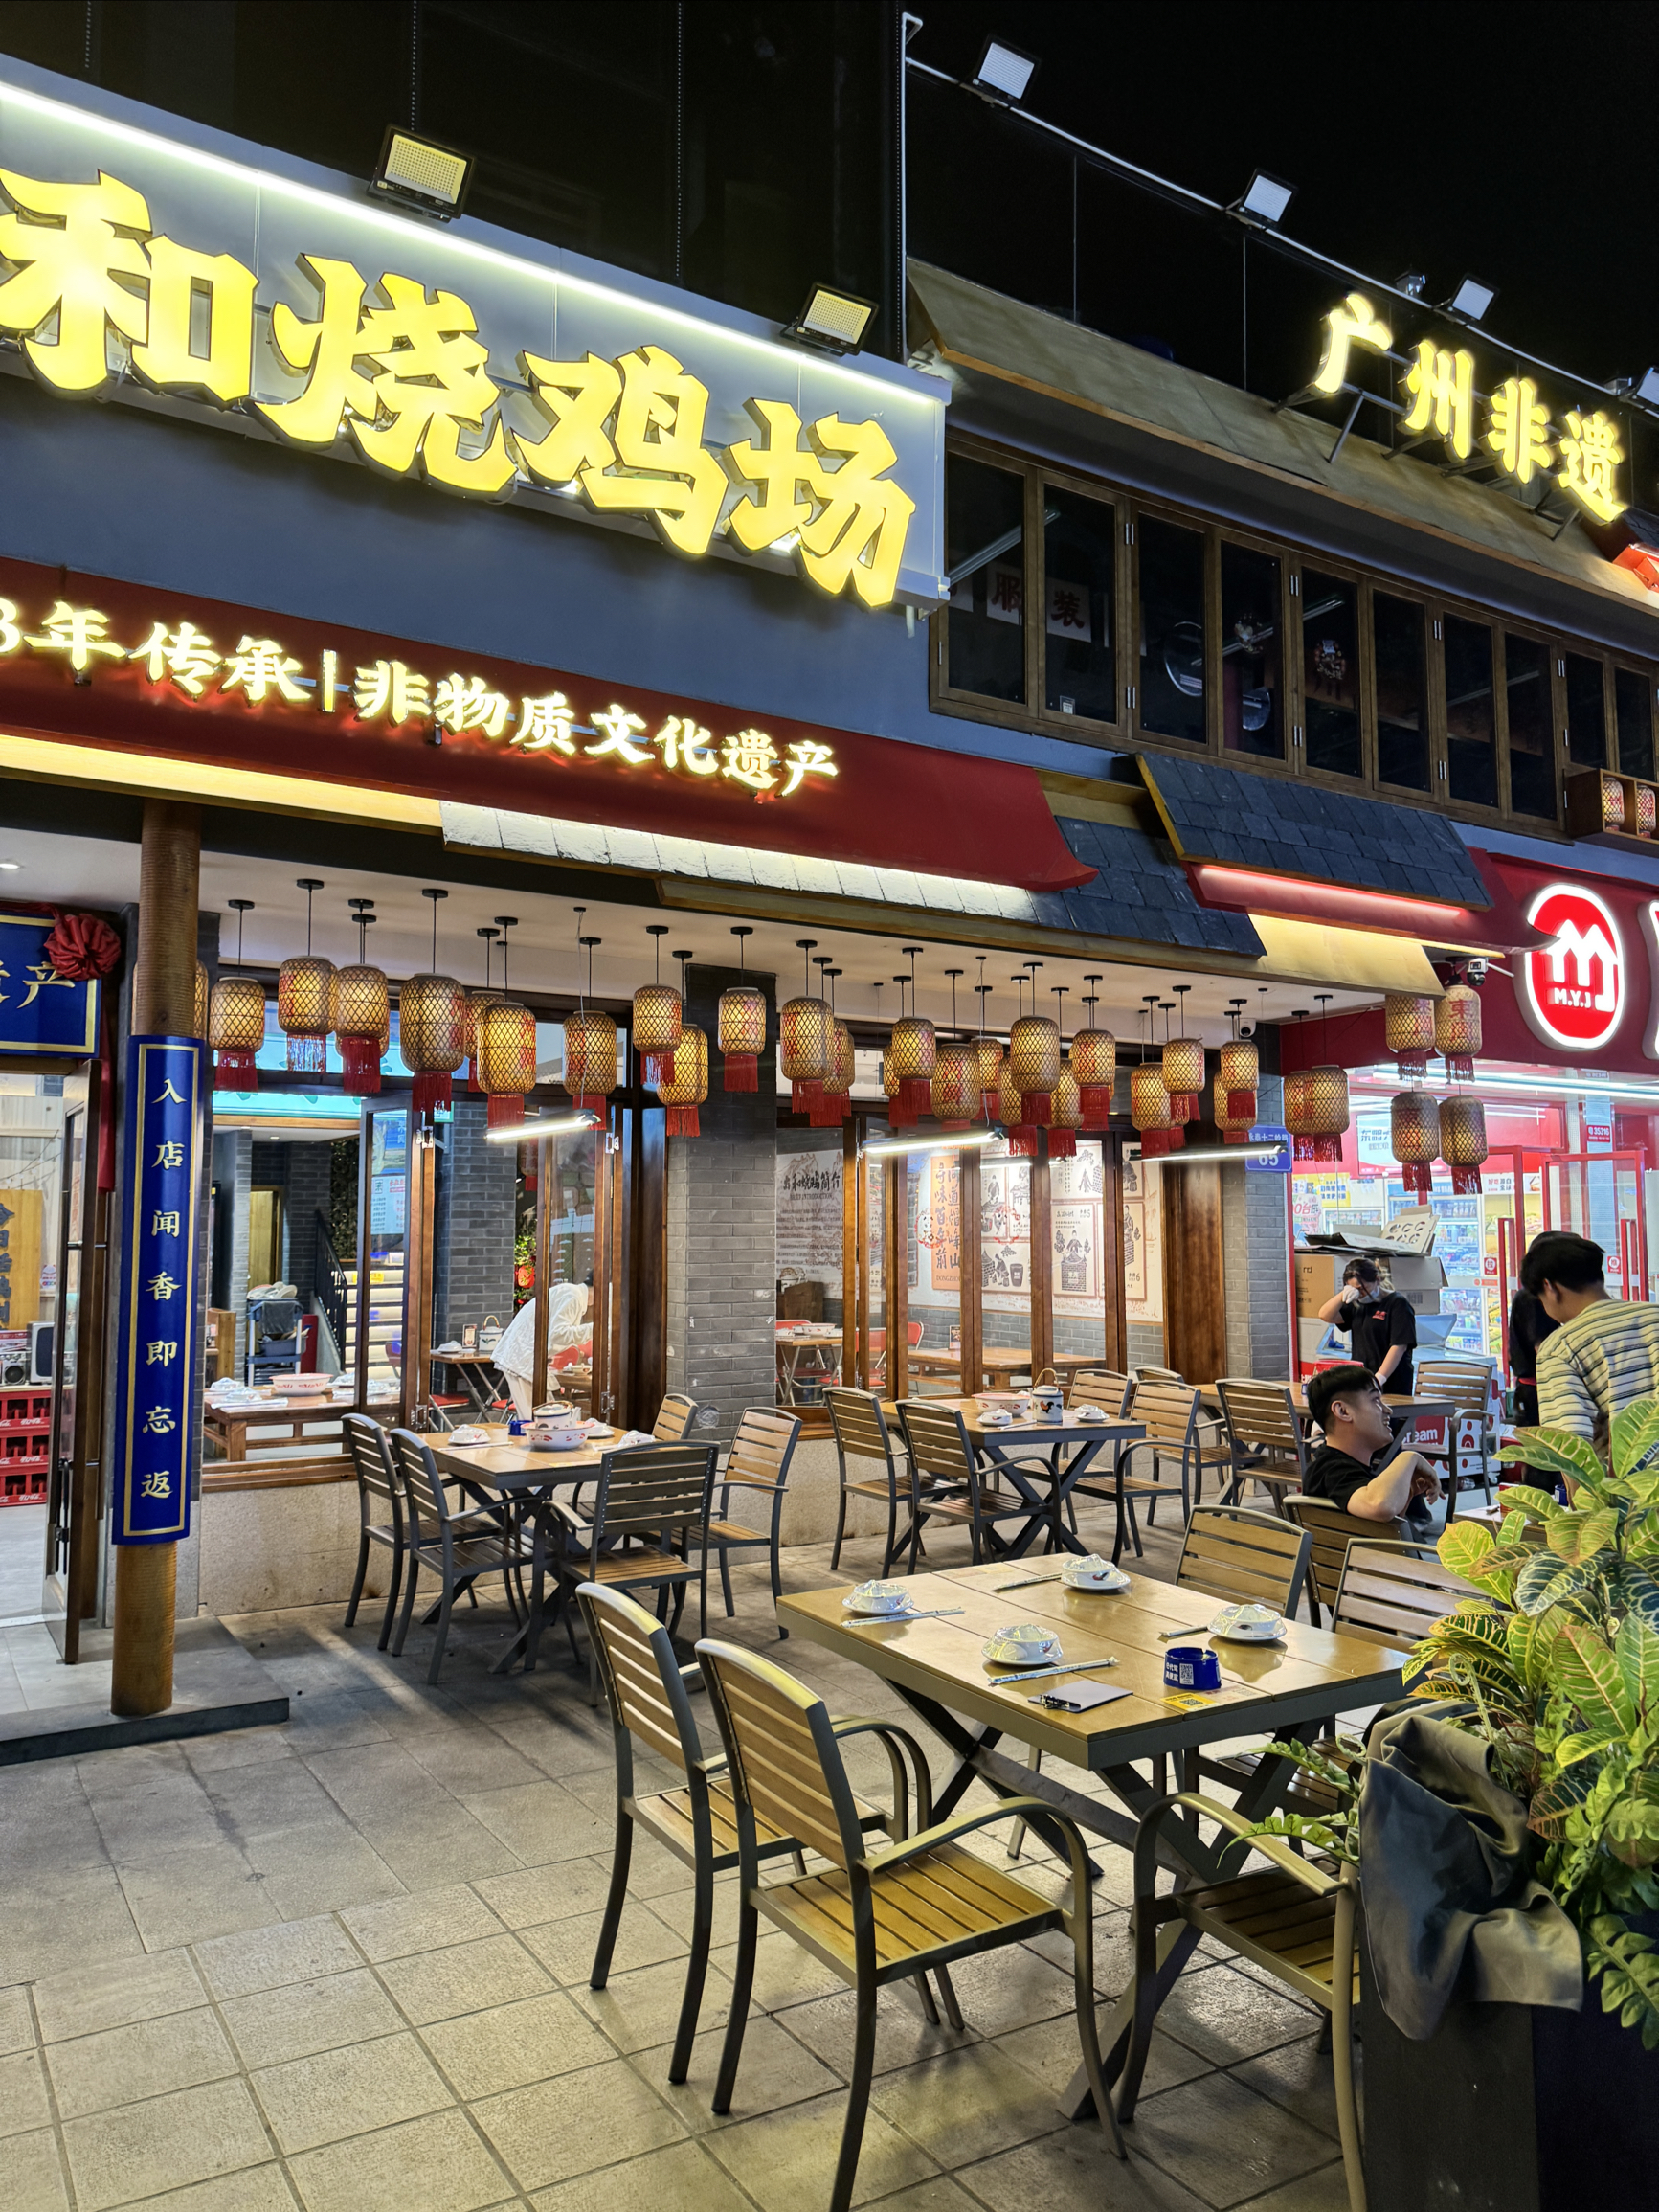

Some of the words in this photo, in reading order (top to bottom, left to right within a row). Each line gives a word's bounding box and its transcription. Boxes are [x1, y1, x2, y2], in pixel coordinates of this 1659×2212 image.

[0, 169, 916, 607] 和烧鸡场
[1315, 294, 1626, 525] 广州非遗
[1554, 987, 1591, 1007] M.Y.J
[141, 1078, 187, 1499] 入店闻香即忘返
[1402, 1428, 1438, 1443] ream
